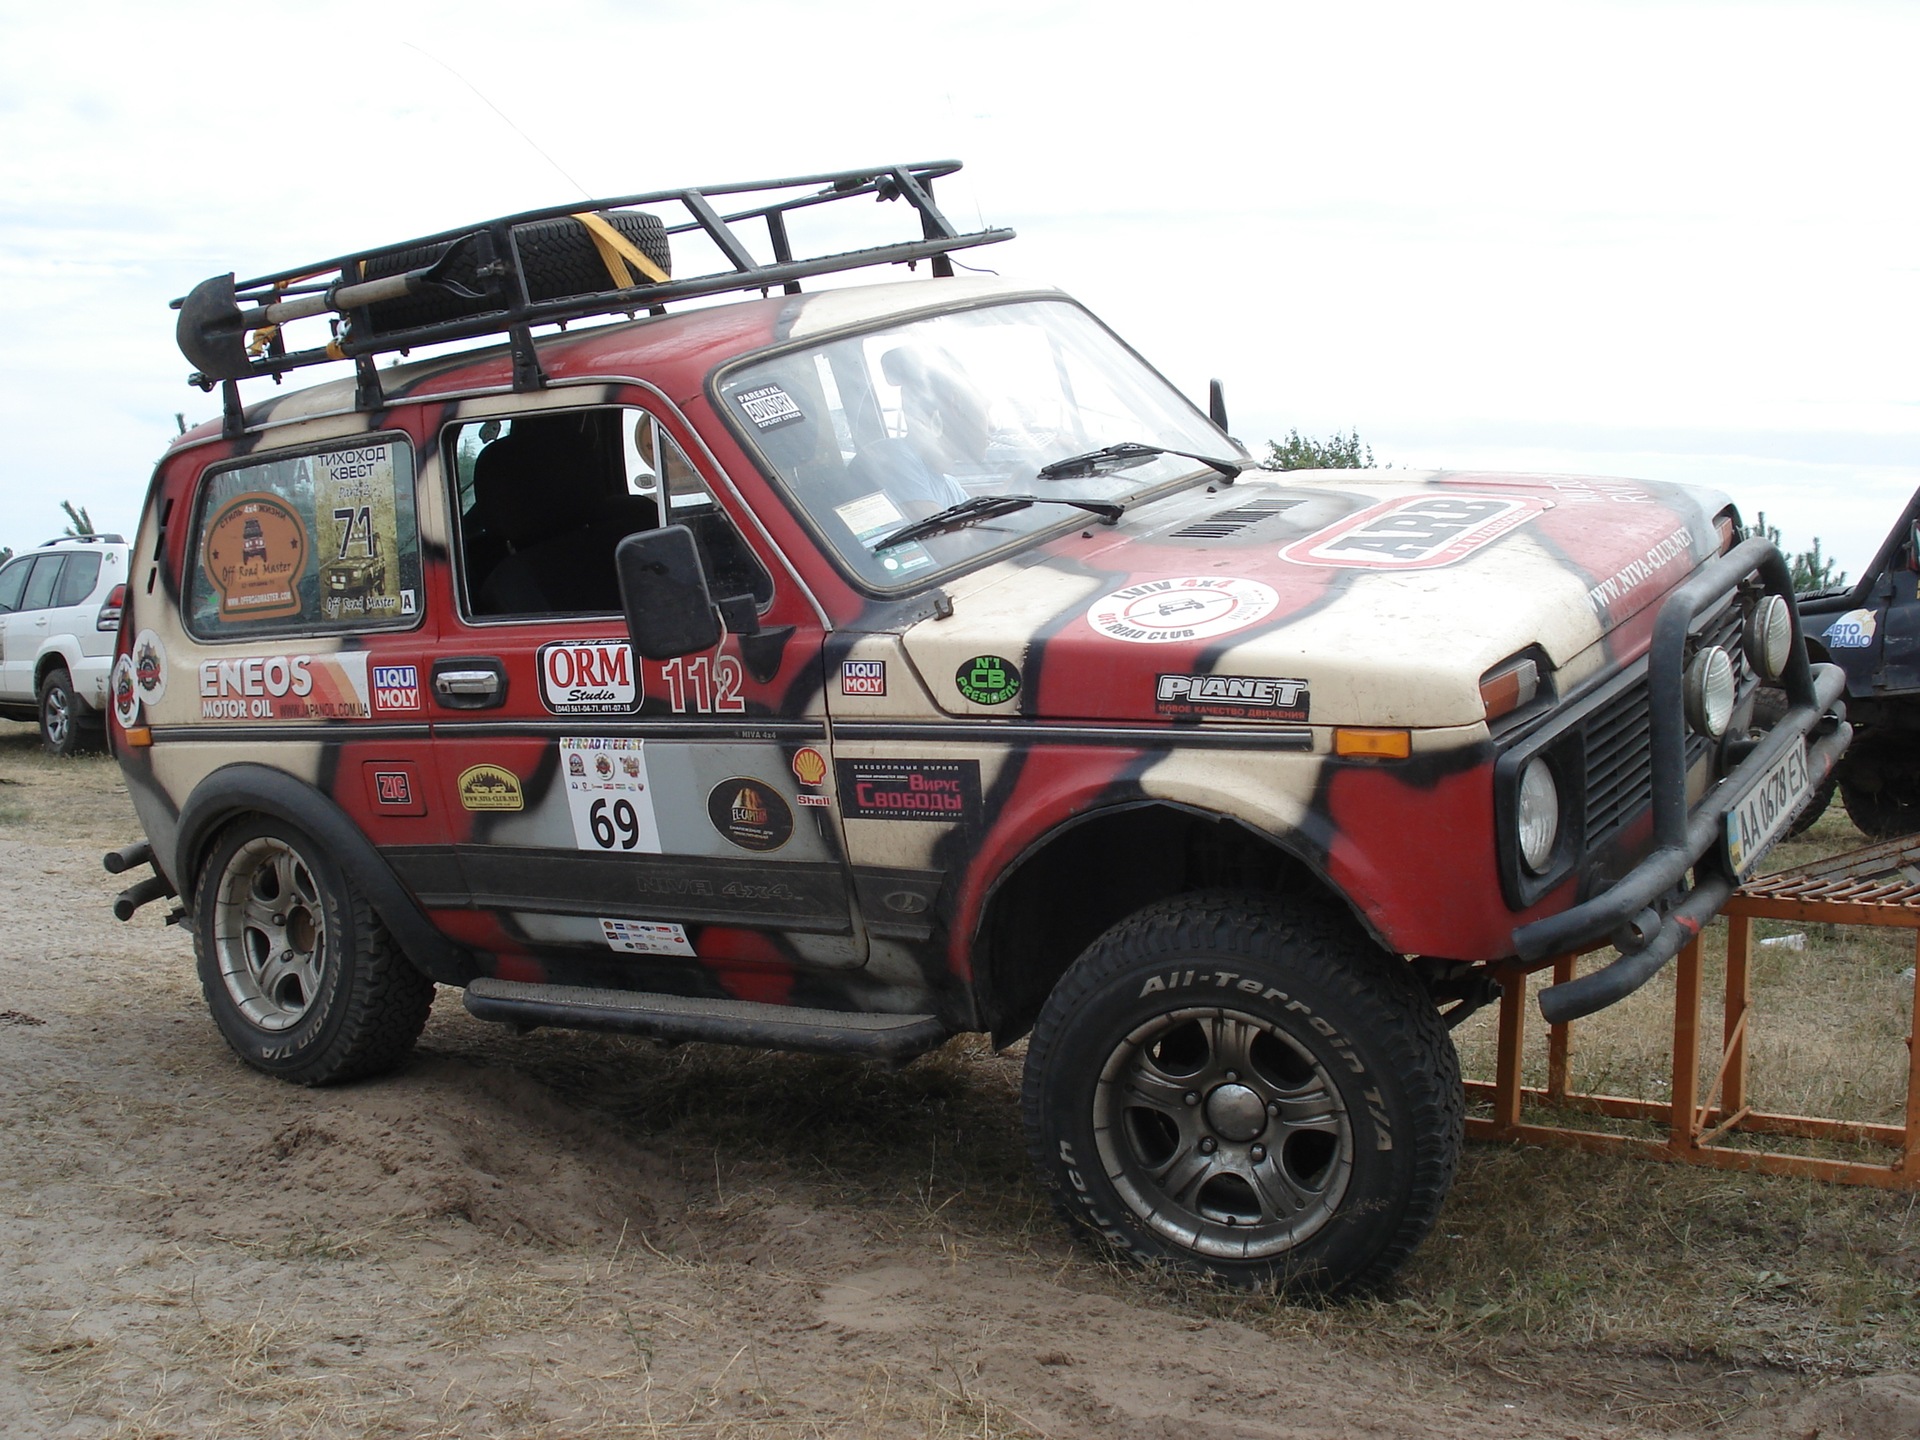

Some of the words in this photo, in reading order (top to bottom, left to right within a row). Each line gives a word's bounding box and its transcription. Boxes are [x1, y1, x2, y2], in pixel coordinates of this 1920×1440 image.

[737, 386, 782, 403] PARENTAL
[746, 394, 795, 421] ADVISORY
[758, 416, 783, 428] EXPLICIT
[318, 447, 386, 467] ТИХОХОД
[330, 464, 375, 481] КВЕСТ
[220, 509, 243, 529] СТИЛЬ
[258, 505, 287, 521] ЖИЗНИ
[333, 505, 374, 560] 71
[1326, 500, 1512, 559] ARB
[223, 565, 236, 587] Off
[239, 563, 260, 580] Road
[263, 562, 291, 576] Master
[1584, 526, 1694, 613] WWW.NIVA-CLUB.NET
[1112, 581, 1172, 600] LVIV
[327, 596, 341, 619] Off
[342, 595, 365, 614] Road
[366, 596, 396, 610] Master
[1098, 612, 1118, 626] OFF
[1828, 623, 1860, 635] АВТО
[1105, 622, 1147, 639] ROAD
[1147, 629, 1195, 640] CLUB
[201, 655, 313, 697] ENEOS
[548, 647, 630, 688] ORM
[845, 662, 880, 678] LIQUI
[375, 668, 415, 688] LIQUI
[662, 656, 746, 713] 112
[846, 678, 882, 693] MOLY
[971, 669, 1006, 688] CB
[377, 688, 417, 708] MOLY
[567, 689, 616, 702] Studio
[957, 676, 1020, 704] PRESIDENT
[1157, 674, 1309, 707] PLANET
[202, 700, 248, 719] MOTOR
[250, 699, 274, 718] OIL
[555, 704, 570, 713] (044)
[1158, 704, 1191, 714] НОВОЕ
[1194, 706, 1245, 717] КАЧЕСТВО
[1248, 708, 1306, 719] ДВИЖЕНИЯ
[561, 738, 601, 750] OFFROAD
[602, 738, 643, 751] FREEFEST
[762, 731, 777, 739] 4x4
[379, 776, 407, 799] ZIC
[797, 795, 831, 806] Shell
[1740, 800, 1761, 858] AA
[1760, 765, 1787, 831] 0678
[1788, 743, 1808, 797] EX
[589, 798, 639, 850] 69
[636, 876, 714, 896] NIVA
[722, 881, 793, 900] 4x4
[262, 1044, 294, 1060] T/A
[1139, 969, 1365, 1074] All-Terrain
[1362, 1086, 1394, 1152] T/A
